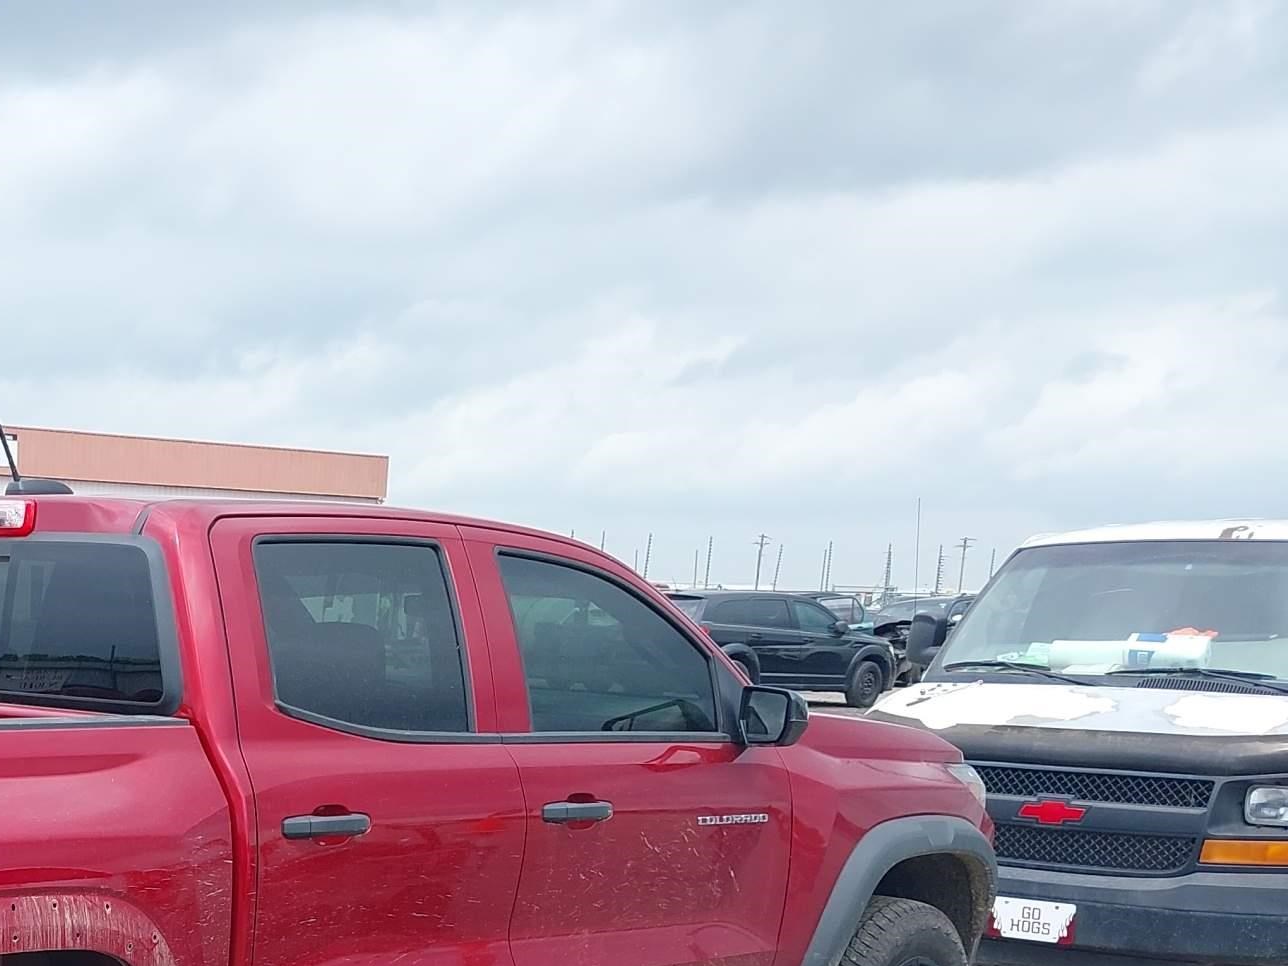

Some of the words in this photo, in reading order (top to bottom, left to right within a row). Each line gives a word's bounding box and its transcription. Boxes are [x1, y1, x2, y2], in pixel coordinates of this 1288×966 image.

[696, 813, 769, 826] COLORADO
[1021, 905, 1041, 921] GO
[1009, 918, 1051, 936] HOGS
